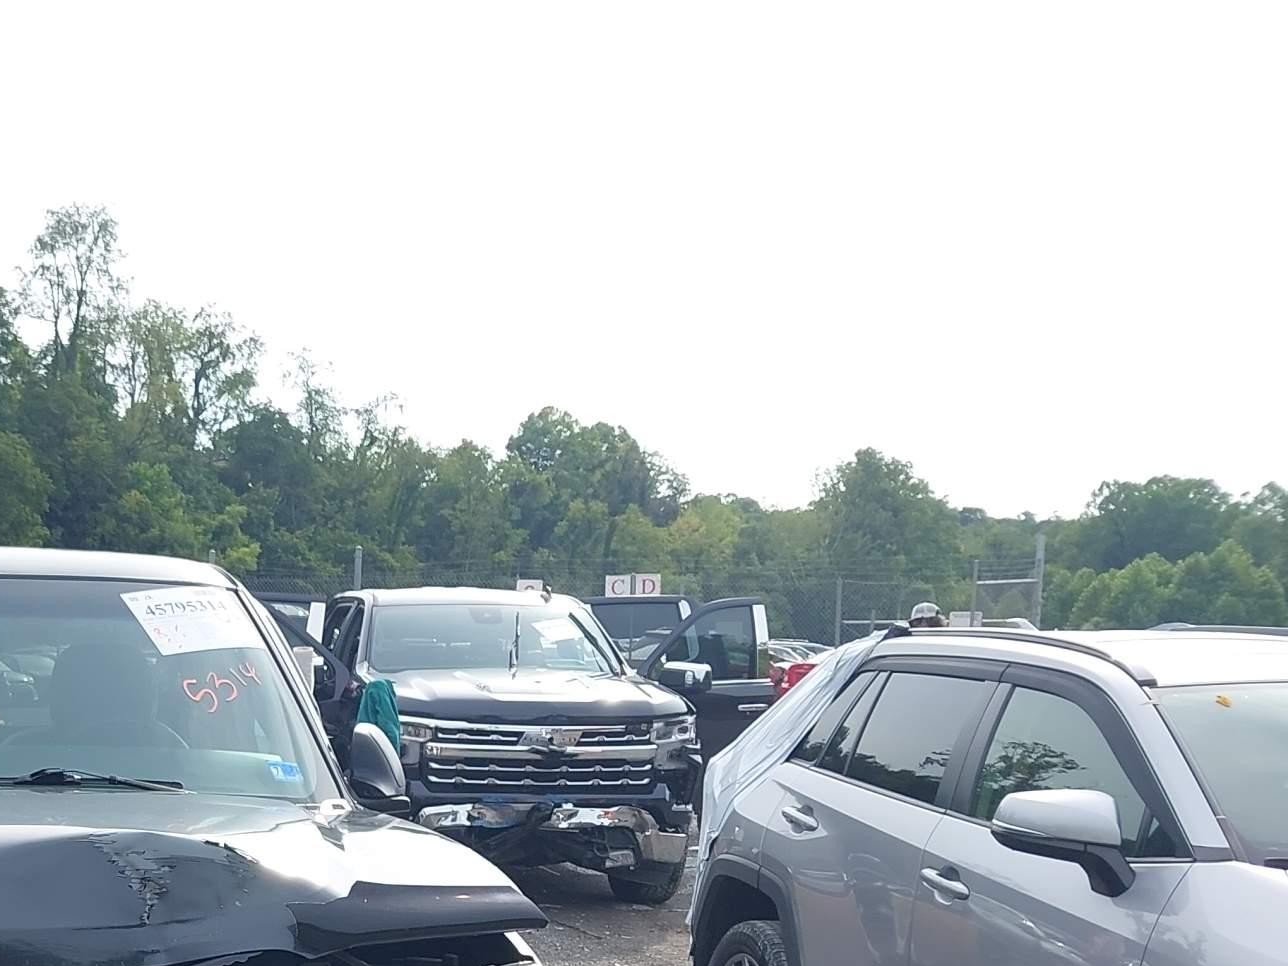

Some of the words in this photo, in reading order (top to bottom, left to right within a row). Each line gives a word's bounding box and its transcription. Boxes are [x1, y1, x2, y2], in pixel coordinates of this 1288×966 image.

[611, 578, 625, 595] C
[642, 577, 656, 595] D
[145, 600, 227, 617] 45795314
[183, 662, 262, 713] 5314
